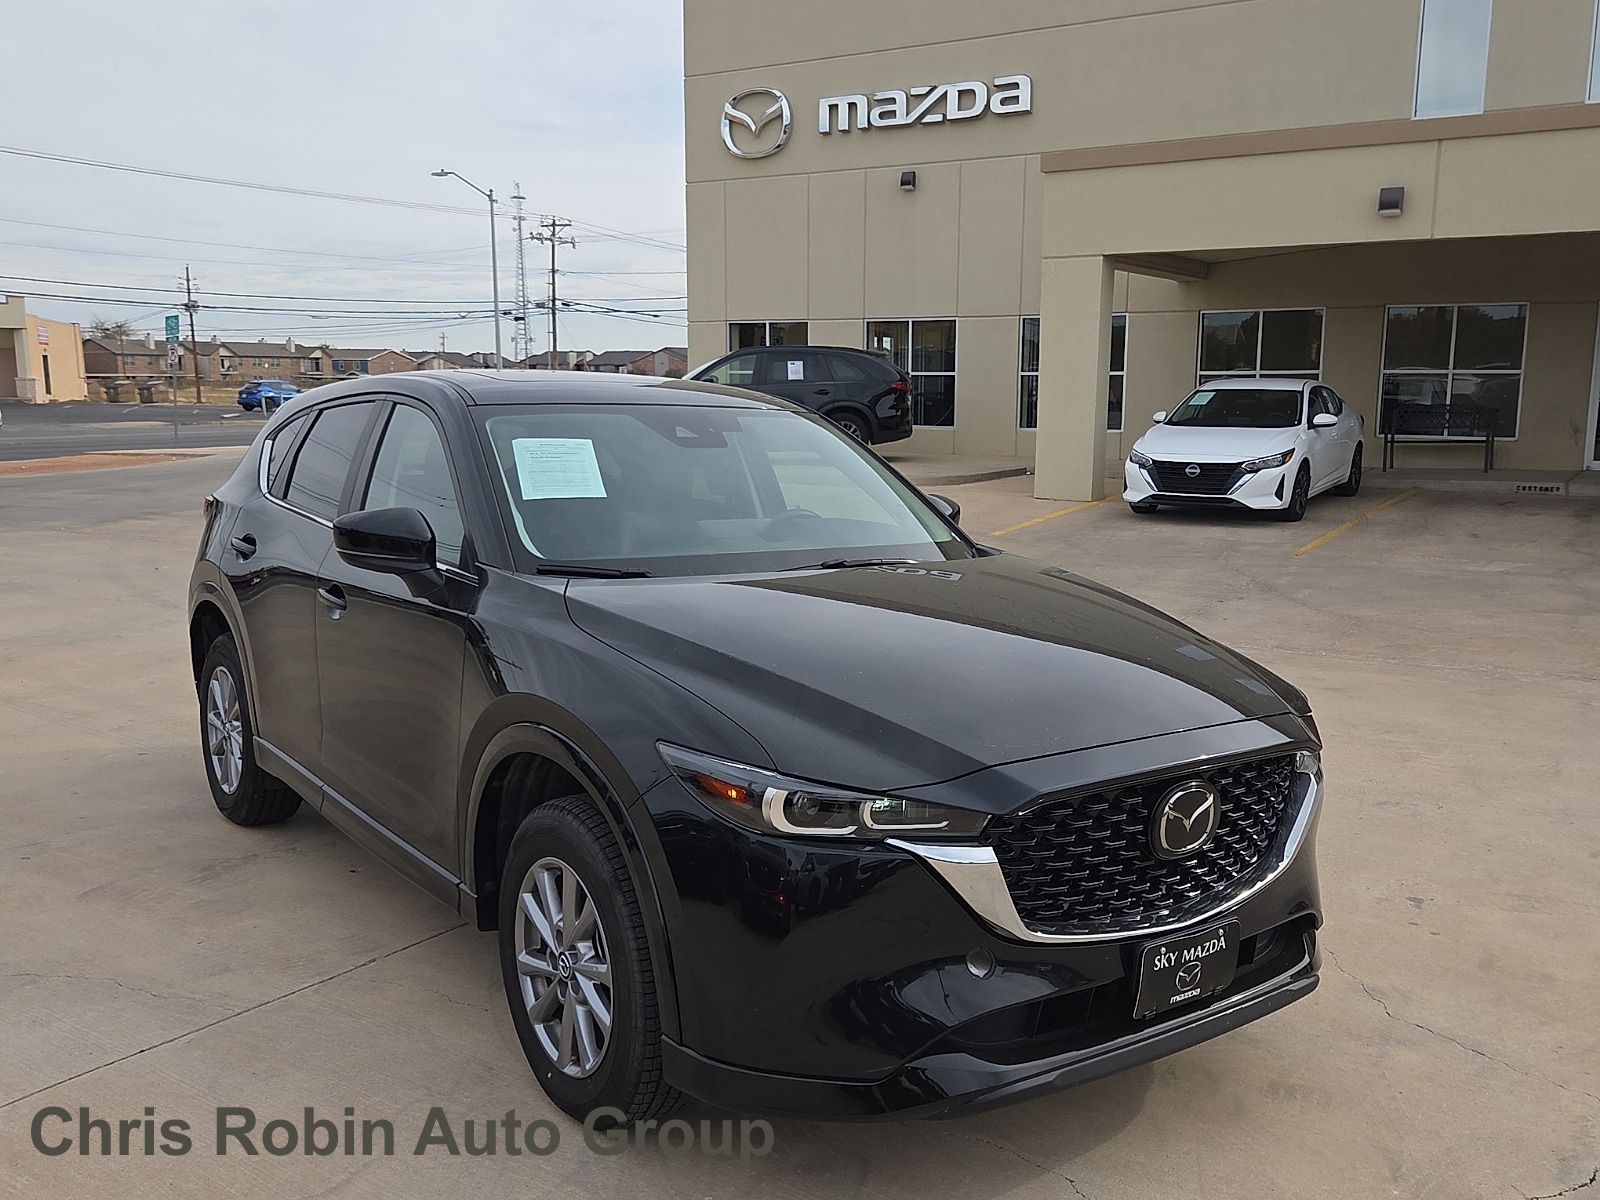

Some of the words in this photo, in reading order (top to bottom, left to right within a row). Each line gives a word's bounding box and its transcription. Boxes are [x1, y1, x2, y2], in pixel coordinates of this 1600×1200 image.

[1516, 485, 1561, 493] CUSTOMER
[1153, 951, 1179, 970] SKY
[1181, 936, 1226, 963] MAZDA
